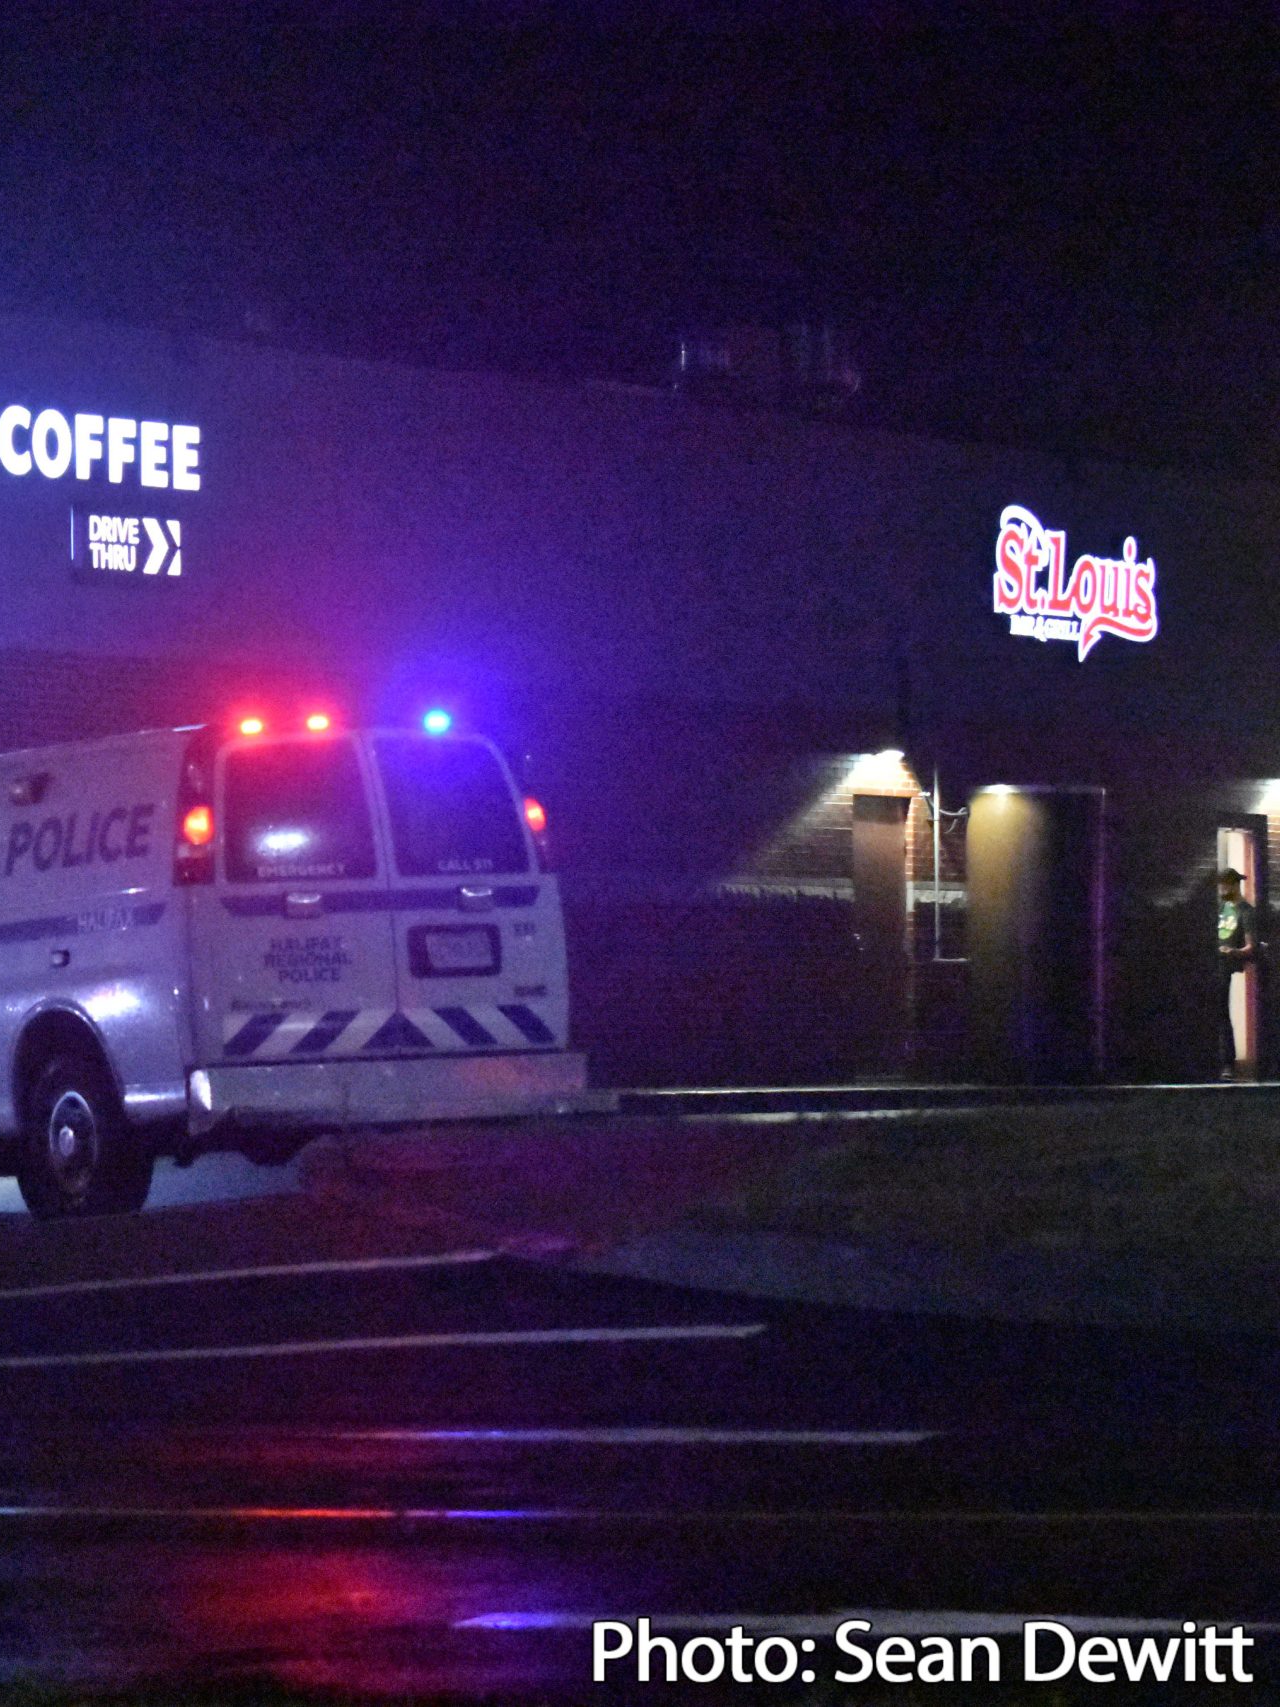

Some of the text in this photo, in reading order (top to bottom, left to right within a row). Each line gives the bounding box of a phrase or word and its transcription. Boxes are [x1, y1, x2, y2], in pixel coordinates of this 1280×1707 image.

[88, 514, 140, 545] DRIVE
[89, 543, 137, 572] THRU
[3, 803, 155, 877] POLICE
[257, 864, 345, 878] EMERGENCY
[437, 859, 471, 872] CALL
[270, 936, 343, 952] HALIFAX
[264, 950, 352, 968] REGIONAL
[277, 967, 341, 984] POLICE
